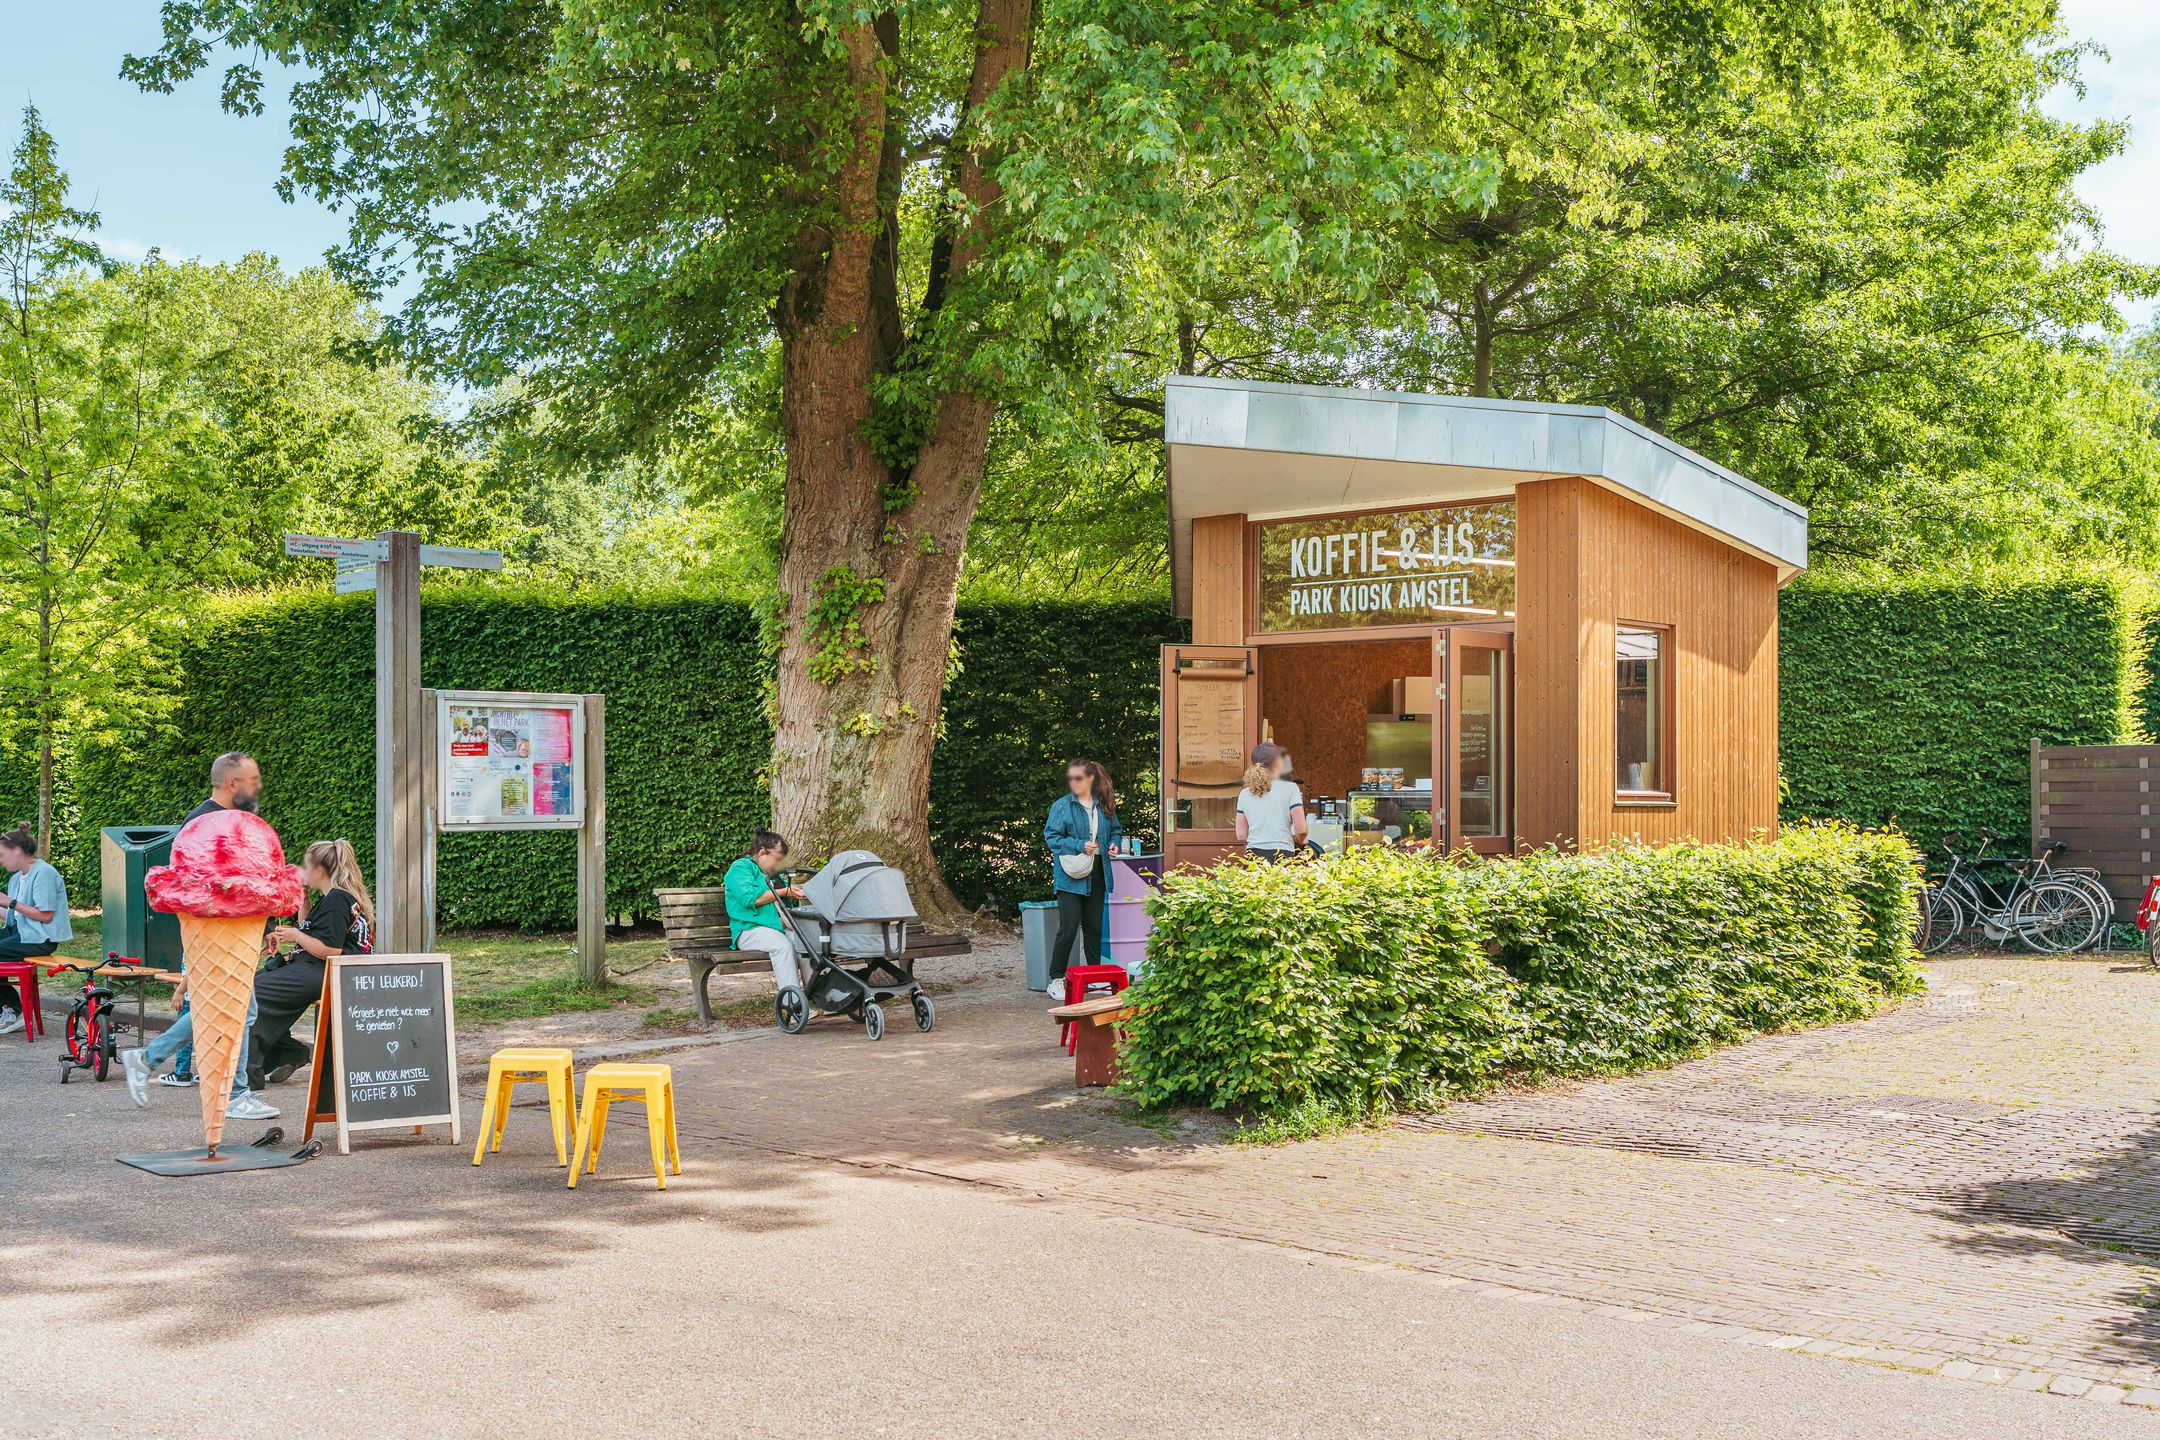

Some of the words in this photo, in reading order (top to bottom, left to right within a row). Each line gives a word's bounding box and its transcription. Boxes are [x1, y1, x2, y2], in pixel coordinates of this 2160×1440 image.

[1291, 530, 1388, 578] KOFFIE
[1399, 527, 1421, 570] &
[1433, 522, 1475, 567] IJS
[1291, 587, 1334, 616] PARK
[1340, 583, 1393, 612] KIOSK
[1398, 577, 1474, 609] AMSTEL
[514, 718, 530, 727] PARK
[354, 975, 375, 990] HEY
[348, 1005, 376, 1021] Vergeet
[376, 1008, 385, 1018] je
[385, 1006, 400, 1017] niet
[400, 1007, 414, 1017] wat
[415, 1008, 431, 1017] meer
[356, 1021, 366, 1031] te
[349, 1071, 372, 1085] PARK
[375, 1070, 400, 1080] KIOSK
[400, 1068, 429, 1079] AMSTEL
[351, 1087, 387, 1103] KOFFIE
[390, 1088, 399, 1099] &
[403, 1085, 417, 1097] IJS
